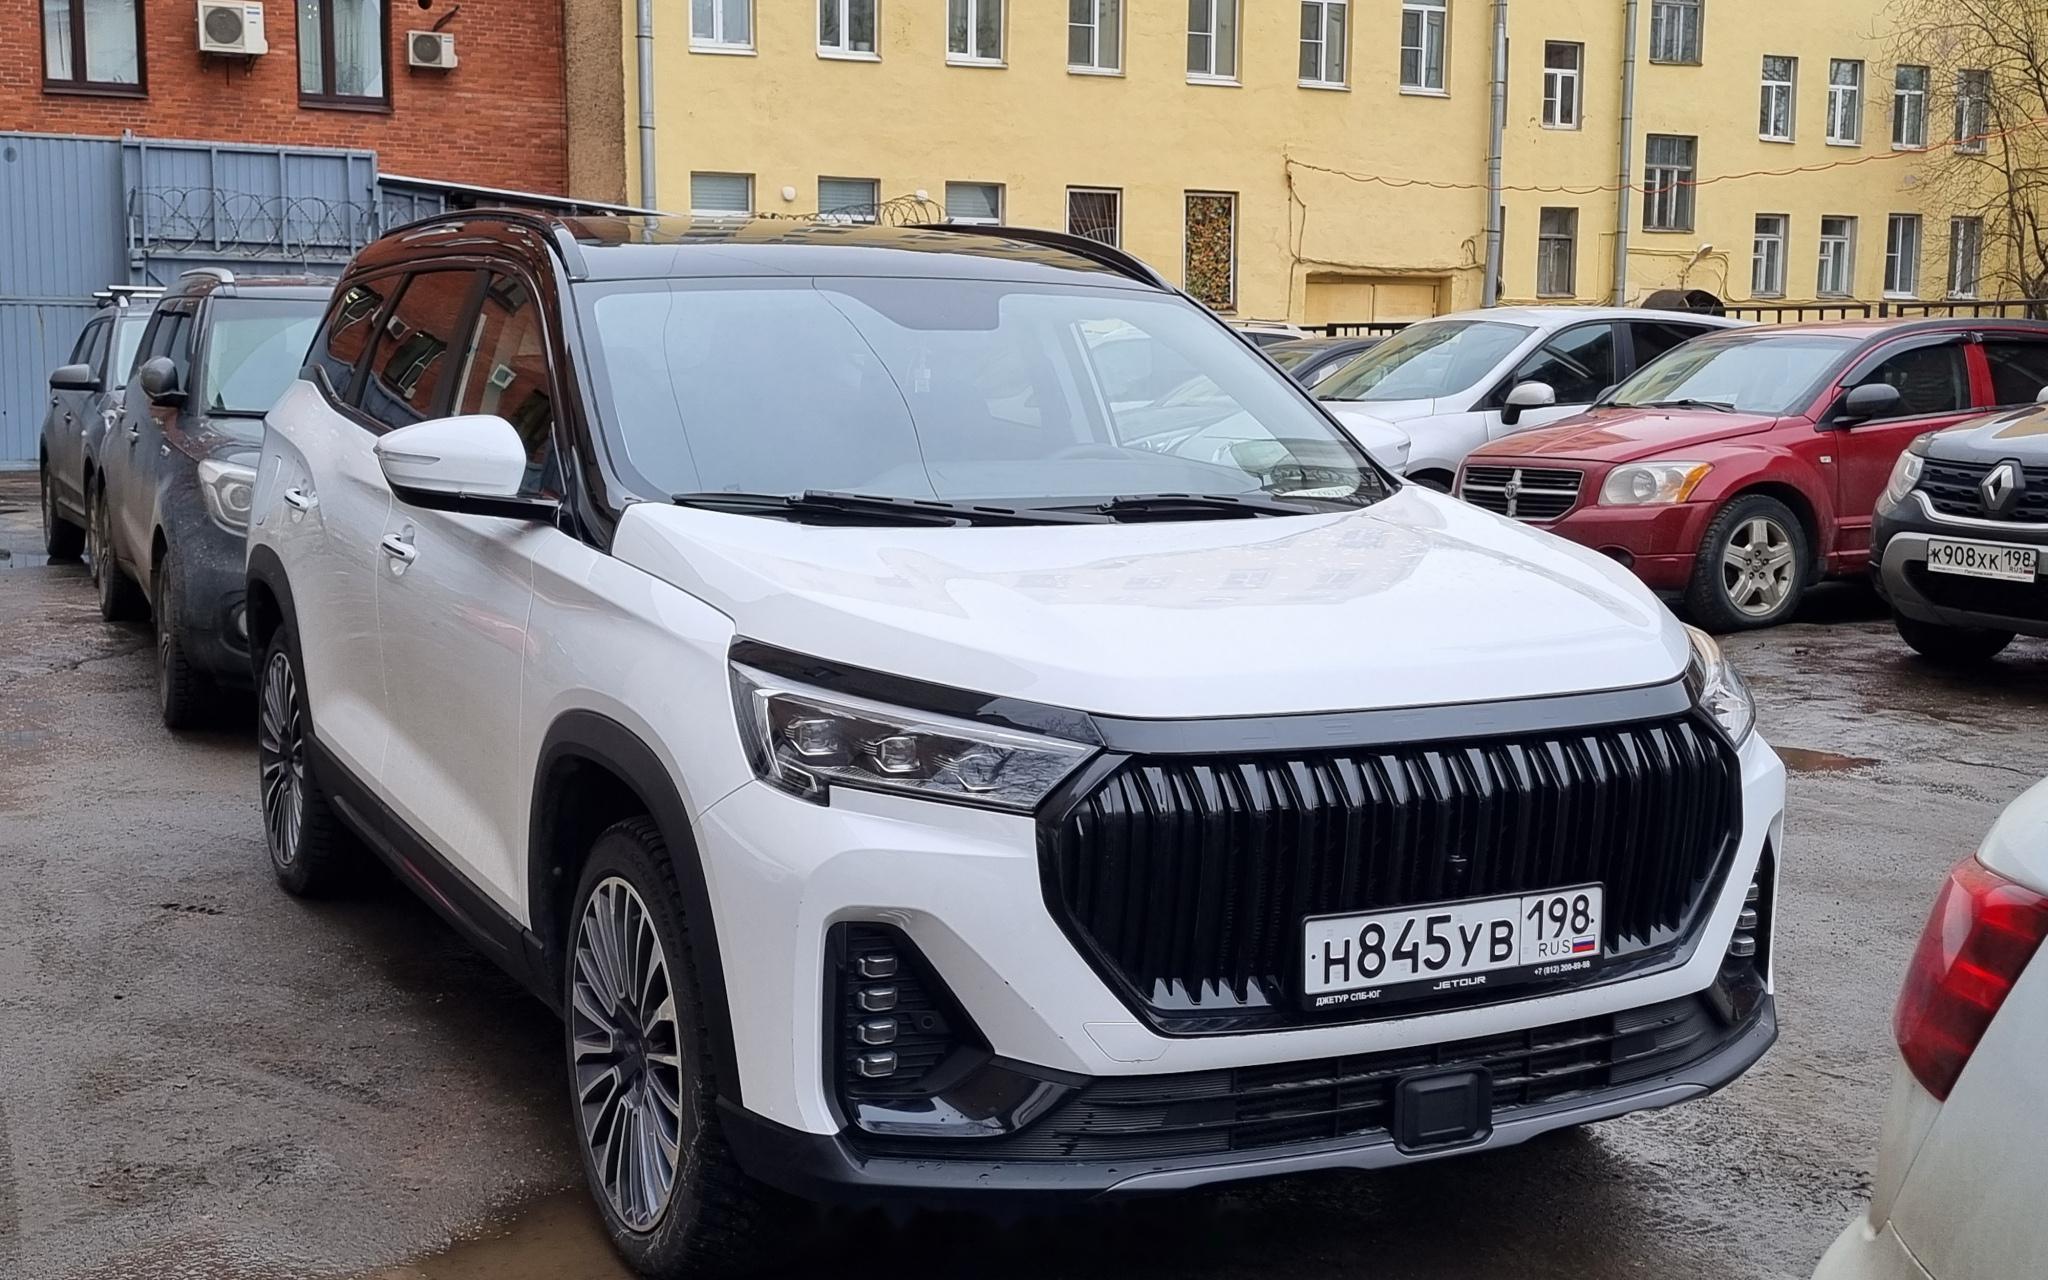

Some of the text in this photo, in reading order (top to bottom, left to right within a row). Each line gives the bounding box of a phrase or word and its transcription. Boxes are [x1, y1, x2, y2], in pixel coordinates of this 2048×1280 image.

[1930, 544, 2031, 570] К908ХК 198
[1324, 894, 1590, 985] Н845УВ 198
[1538, 940, 1571, 957] RUS
[1534, 966, 1543, 976] +7
[1543, 965, 1560, 976] (812)
[1433, 975, 1487, 990] JETOUR
[1315, 989, 1382, 1007] ДЖЕТУР СПБ-ЮГ
